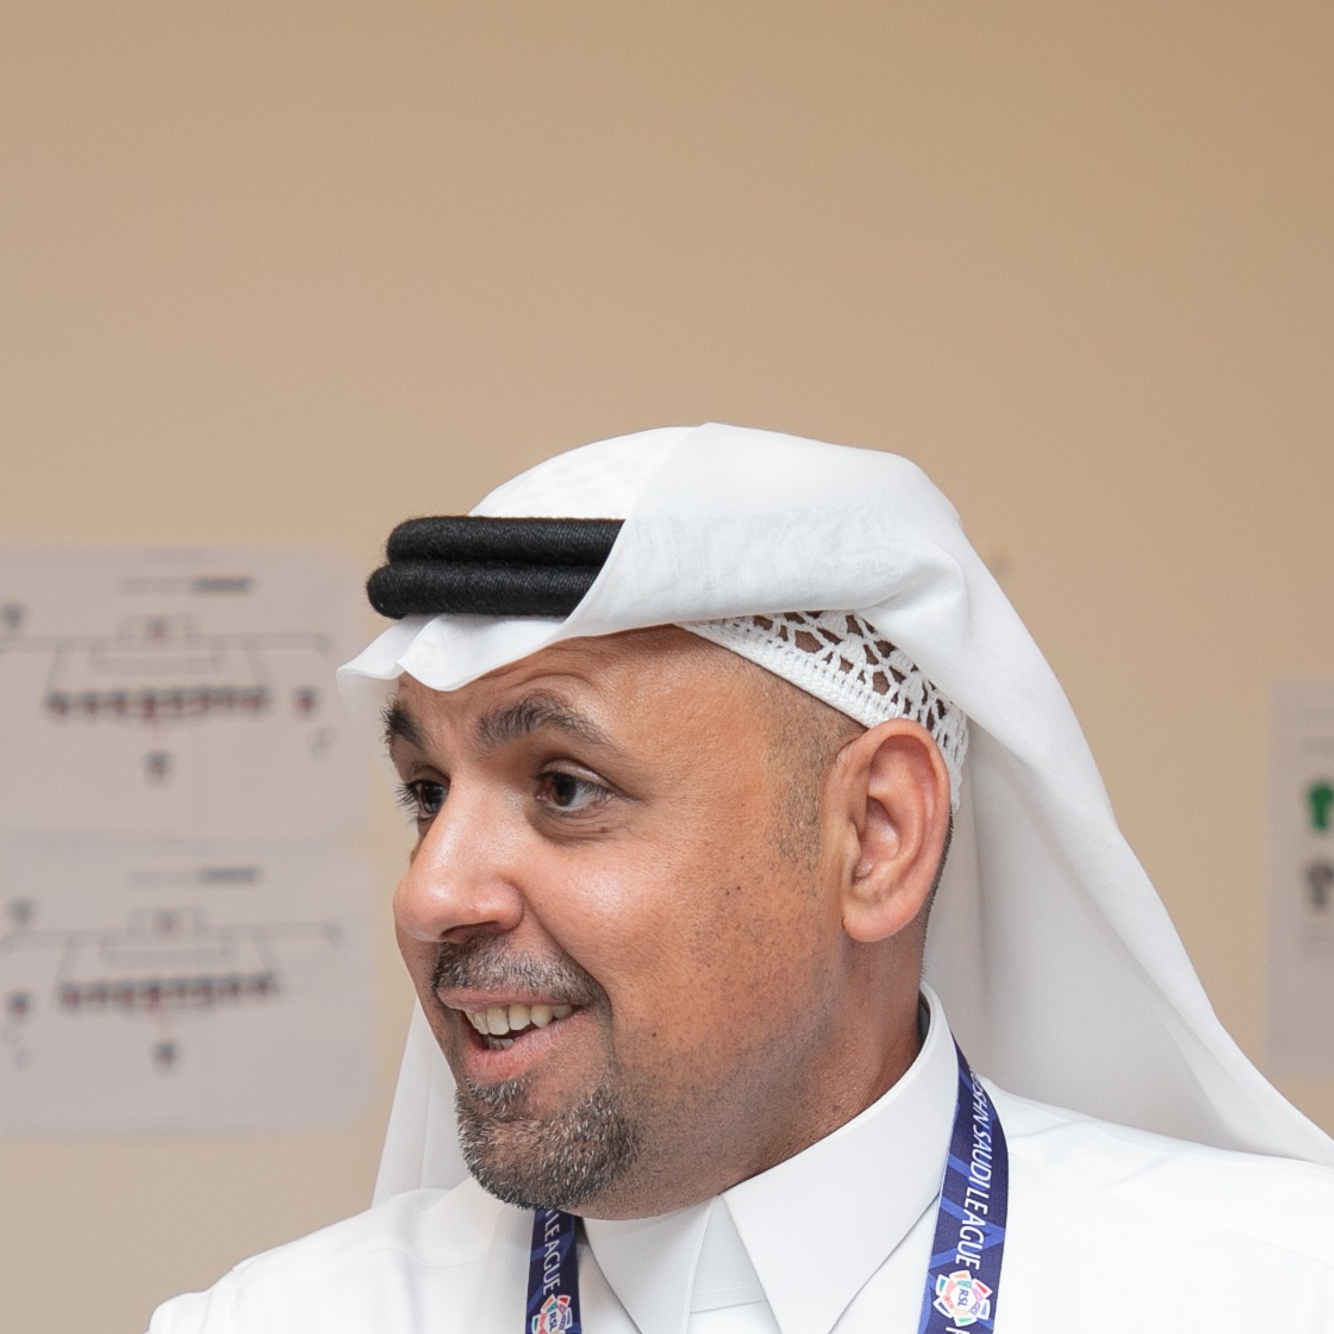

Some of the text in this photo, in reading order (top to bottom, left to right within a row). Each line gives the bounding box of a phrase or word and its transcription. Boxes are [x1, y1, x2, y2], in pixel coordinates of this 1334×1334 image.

[969, 1124, 993, 1185] SAUDI
[543, 1213, 561, 1296] LEAGUE
[955, 1186, 989, 1270] LEAGUE
[548, 1311, 558, 1332] RSL
[958, 1288, 969, 1307] RSL
